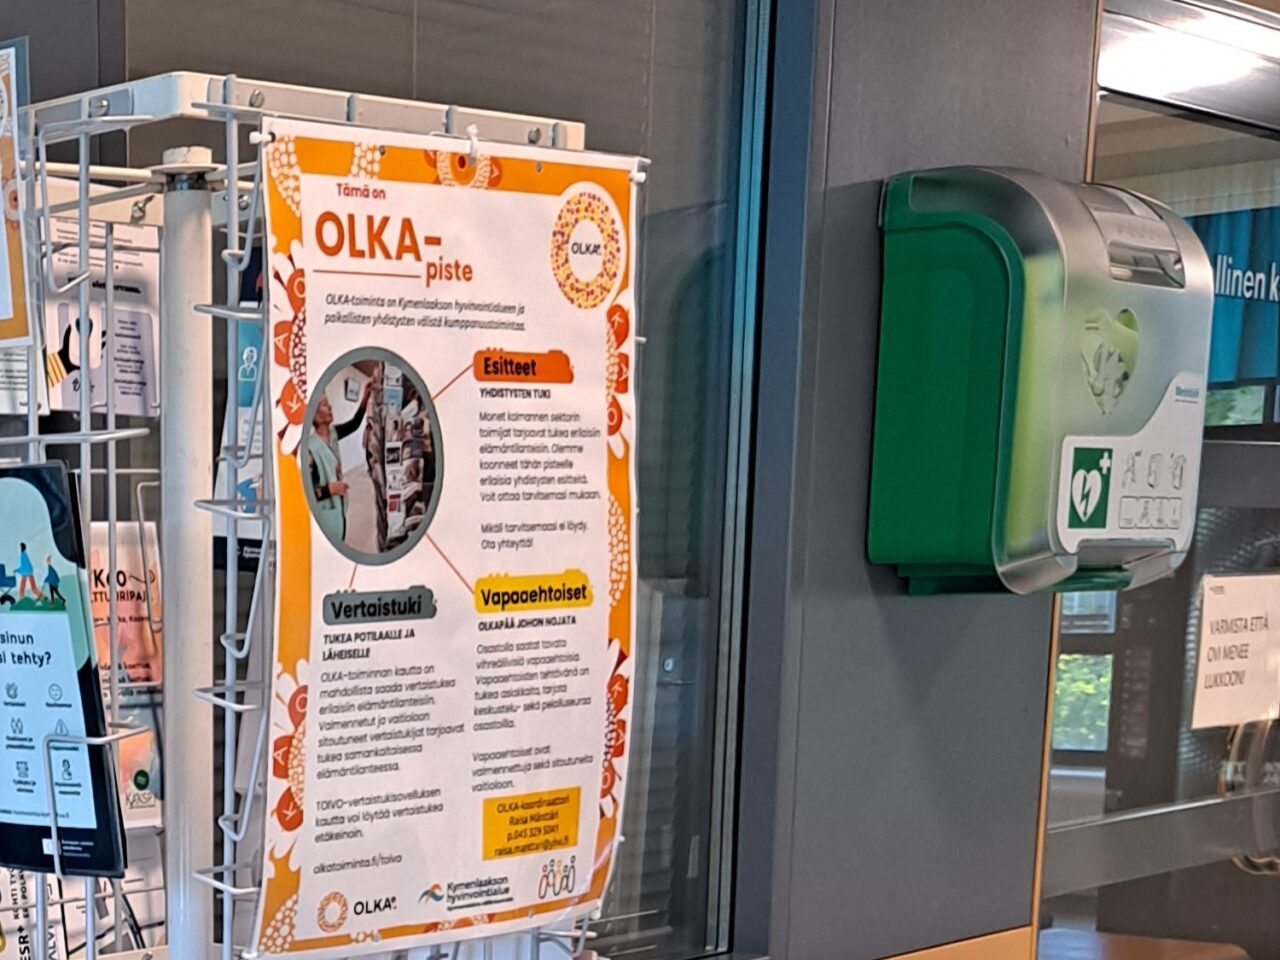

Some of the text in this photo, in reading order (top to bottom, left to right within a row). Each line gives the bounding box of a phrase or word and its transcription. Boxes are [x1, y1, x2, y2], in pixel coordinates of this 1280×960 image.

[337, 183, 386, 199] Tämä on
[315, 211, 442, 262] OLKA-
[426, 256, 473, 287] piste
[326, 293, 385, 307] OLKA-toiminta
[387, 299, 396, 307] on
[398, 298, 453, 310] Kymenlaakson
[518, 304, 525, 316] ja
[325, 312, 370, 325] paikallisten
[372, 314, 415, 327] yhdistysten
[417, 316, 442, 328] välistä
[484, 356, 536, 376] Esitteet
[479, 388, 551, 399] YHDISTYSTEN TUKI
[479, 411, 580, 422] Monet kolmannen sektorin
[520, 460, 541, 470] tähän
[481, 539, 495, 549] Ota
[481, 582, 587, 611] Vapaaehtoiset
[331, 595, 421, 620] Vertaistuki
[478, 616, 576, 631] OLKAPÄÄ JOHON NOJATA
[1209, 617, 1248, 635] VARMISTA
[0, 631, 34, 645] sinun
[324, 628, 415, 645] TUKEA POTILAALLE JA
[11, 651, 51, 668] tehty?
[322, 648, 370, 661] LÄHEISELLE
[395, 666, 422, 676] kautta
[424, 665, 434, 674] on
[375, 683, 402, 694] saada
[347, 813, 360, 823] voi
[362, 810, 390, 823] löytää
[447, 876, 508, 891] Kymenlaakson
[447, 887, 510, 904] hyvinvointialue
